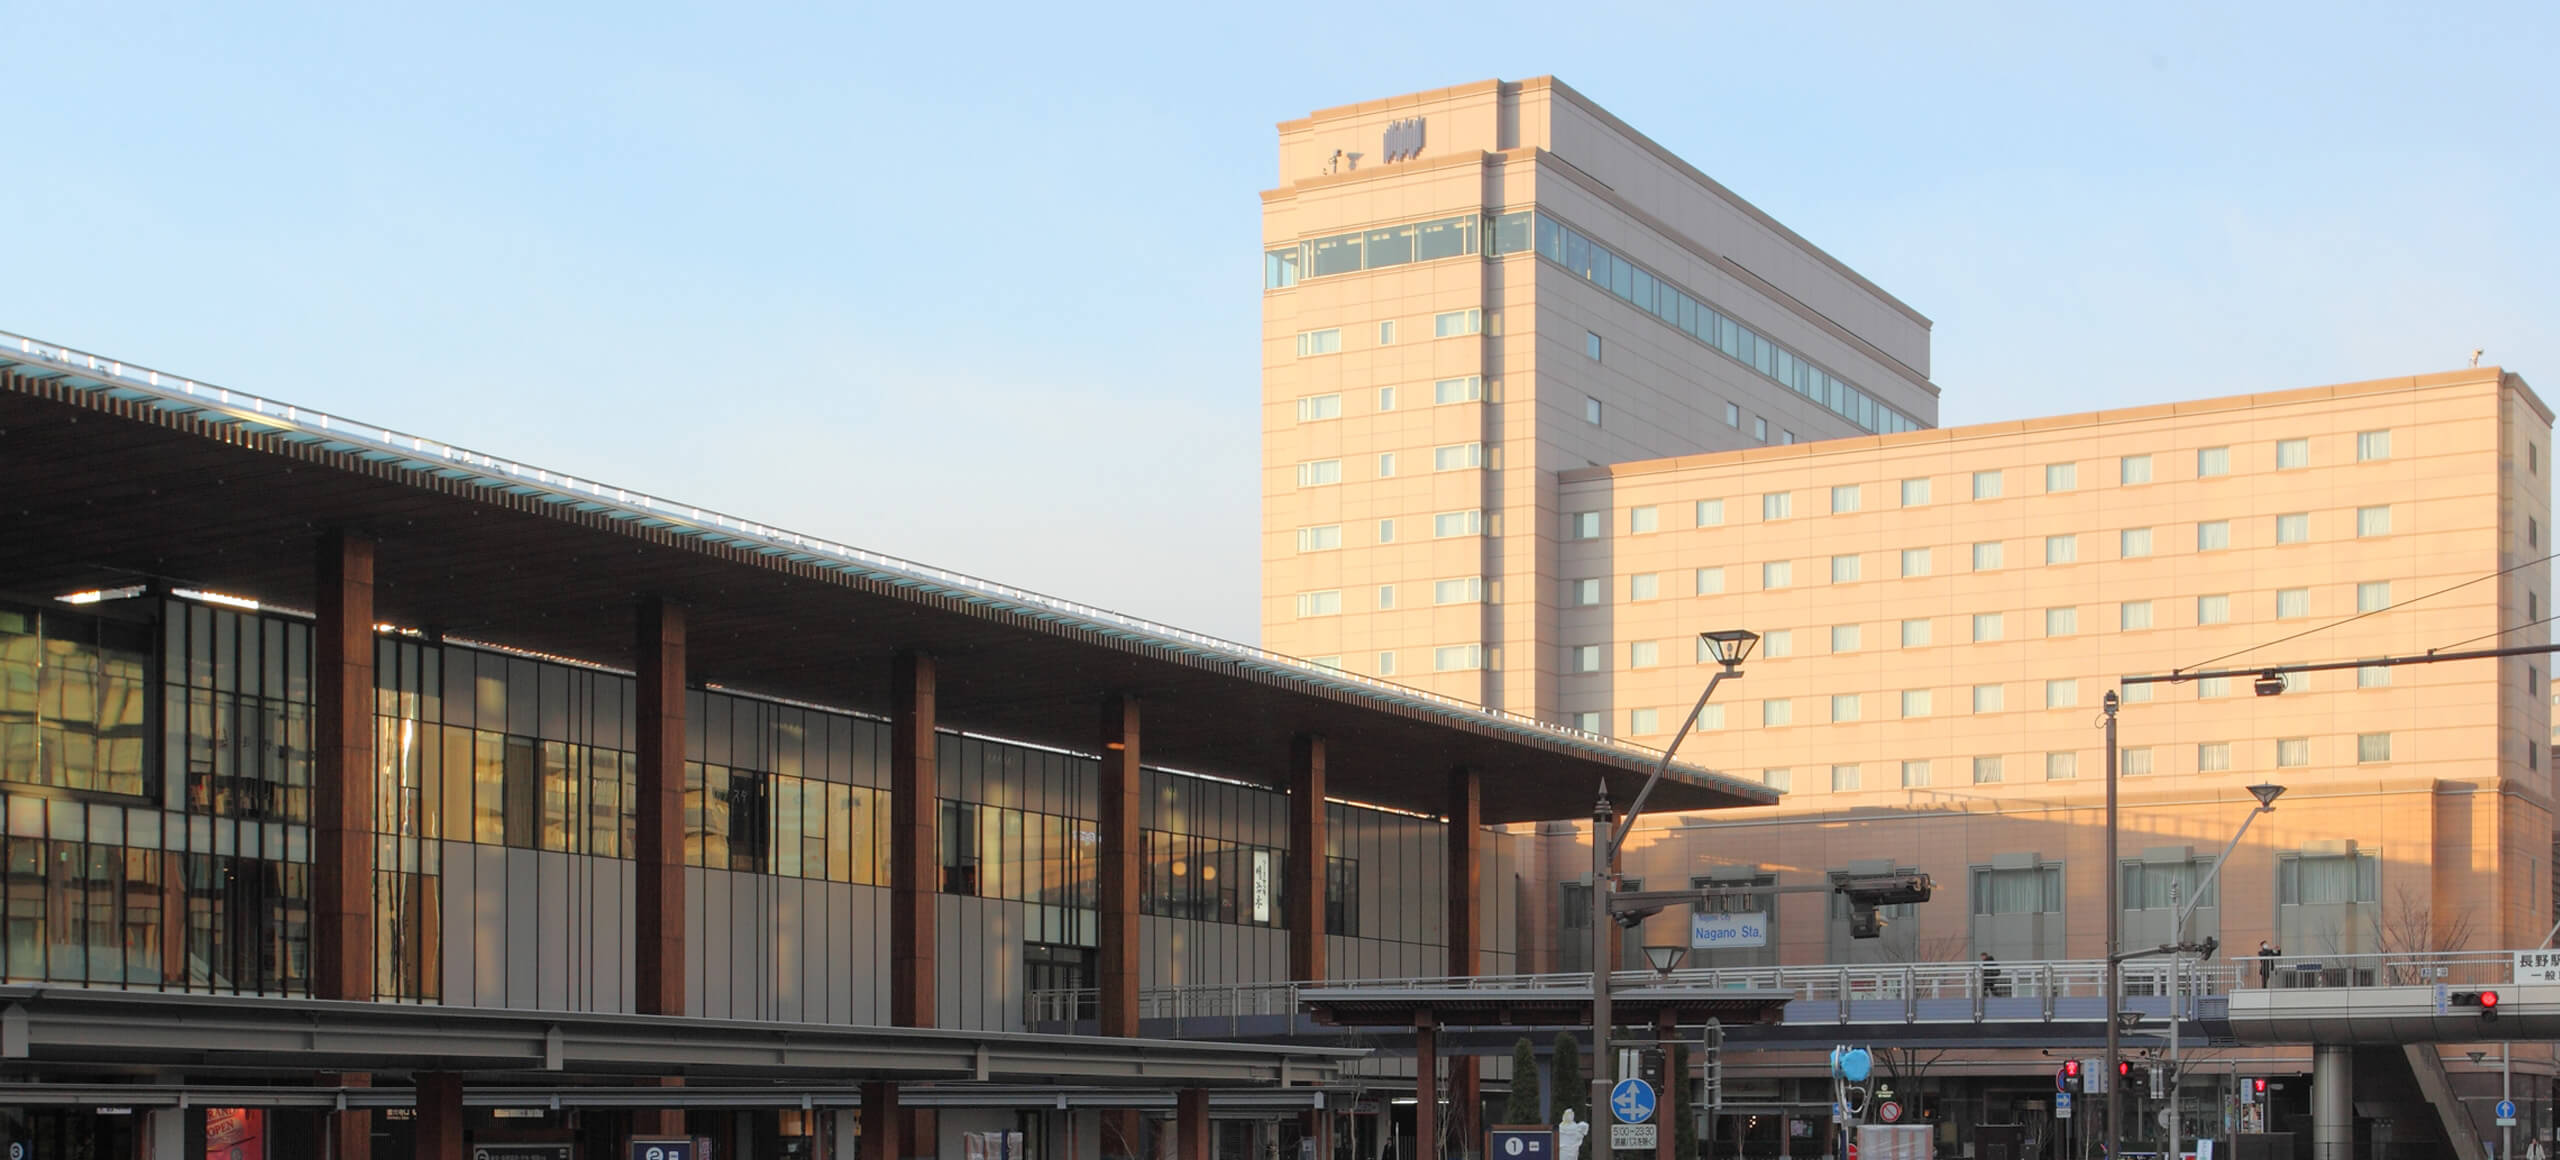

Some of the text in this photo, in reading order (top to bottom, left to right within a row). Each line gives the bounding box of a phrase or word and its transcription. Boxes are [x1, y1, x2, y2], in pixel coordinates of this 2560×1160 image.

[1695, 925, 1762, 941] Nagano Sta.
[2530, 970, 2560, 981] 一般
[207, 1118, 234, 1136] OPEN
